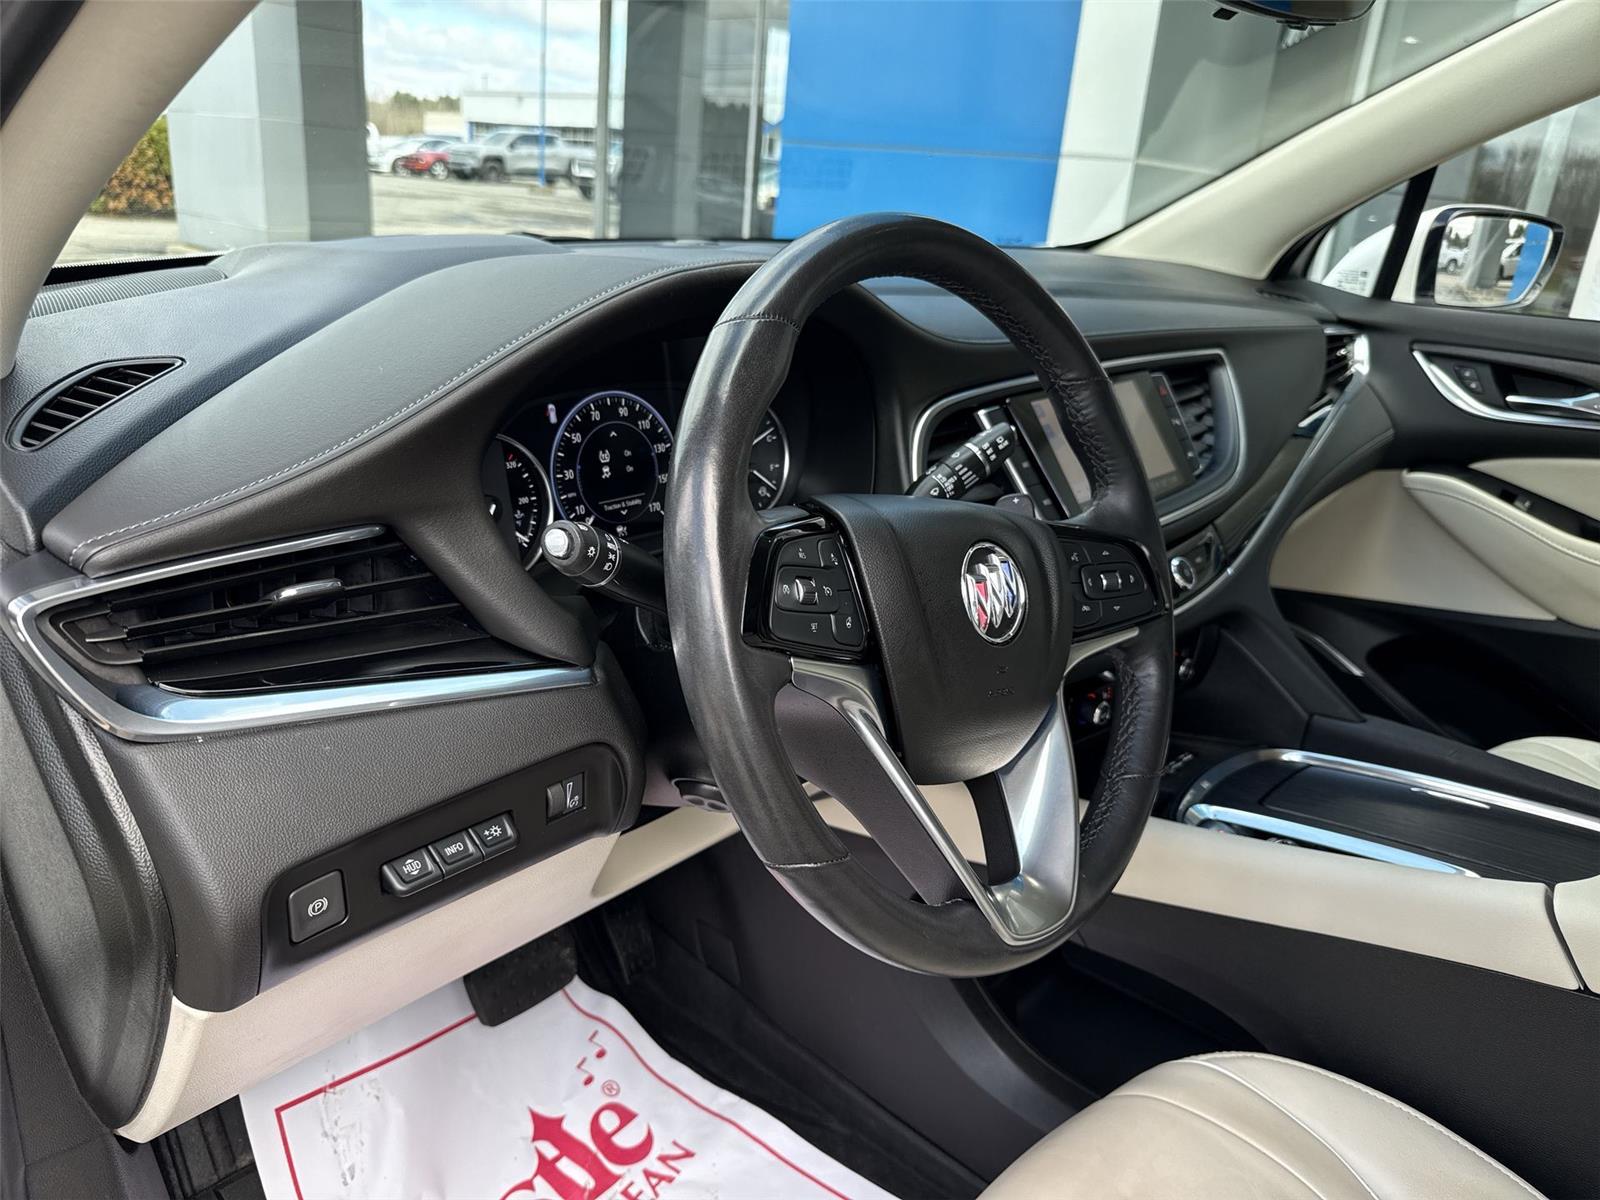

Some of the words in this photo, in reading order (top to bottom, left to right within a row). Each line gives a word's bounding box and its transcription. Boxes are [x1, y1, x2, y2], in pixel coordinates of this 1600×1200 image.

[591, 411, 601, 421] 70
[619, 407, 628, 417] 90
[638, 420, 650, 430] 110
[571, 433, 582, 444] 50
[654, 443, 666, 453] 130
[564, 469, 575, 480] 30
[519, 497, 530, 505] 200
[575, 505, 586, 515] 10
[649, 502, 661, 512] 170
[444, 842, 464, 856] INFO
[402, 860, 421, 874] HUD
